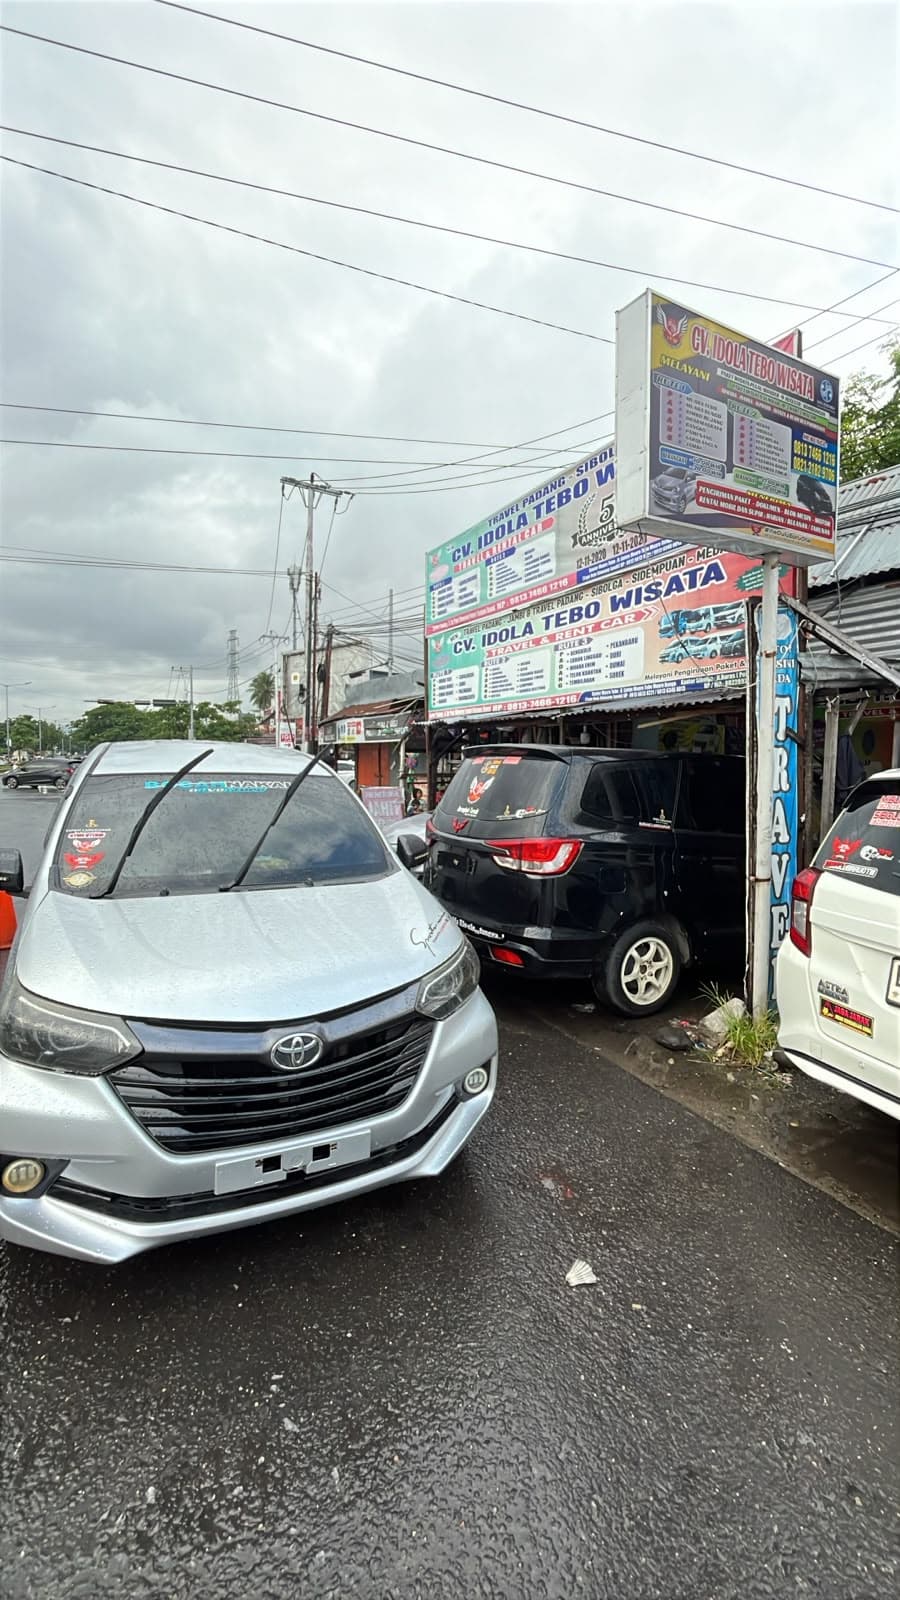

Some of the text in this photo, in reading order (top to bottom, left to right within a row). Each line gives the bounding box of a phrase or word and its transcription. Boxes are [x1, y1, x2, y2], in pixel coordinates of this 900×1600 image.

[660, 354, 710, 382] MELAYANI
[691, 325, 710, 357] CV.
[713, 334, 747, 373] IDOLA
[748, 349, 775, 384] TEBO
[776, 362, 814, 401] WISATA
[452, 542, 474, 563] CV.
[478, 512, 529, 550] IDOLA
[533, 478, 589, 520] TEBO
[488, 503, 521, 527] TRAVEL
[523, 477, 566, 509] PADANG
[533, 602, 555, 615] TRAVEL
[556, 592, 584, 609] PADANG
[591, 579, 623, 598] SIBOLGA
[631, 556, 686, 583] SIDEMPUAN
[696, 546, 726, 560] MED
[454, 637, 476, 654] CV.
[482, 621, 534, 647] IDOLA
[542, 600, 600, 631] TEBO
[610, 562, 725, 612] WISATA
[491, 639, 537, 657] TRAVEL
[555, 625, 595, 641] RENT
[600, 613, 637, 629] CAR
[645, 671, 673, 680] Melayani
[716, 662, 737, 671] Paket
[818, 979, 848, 997] ASTRA
